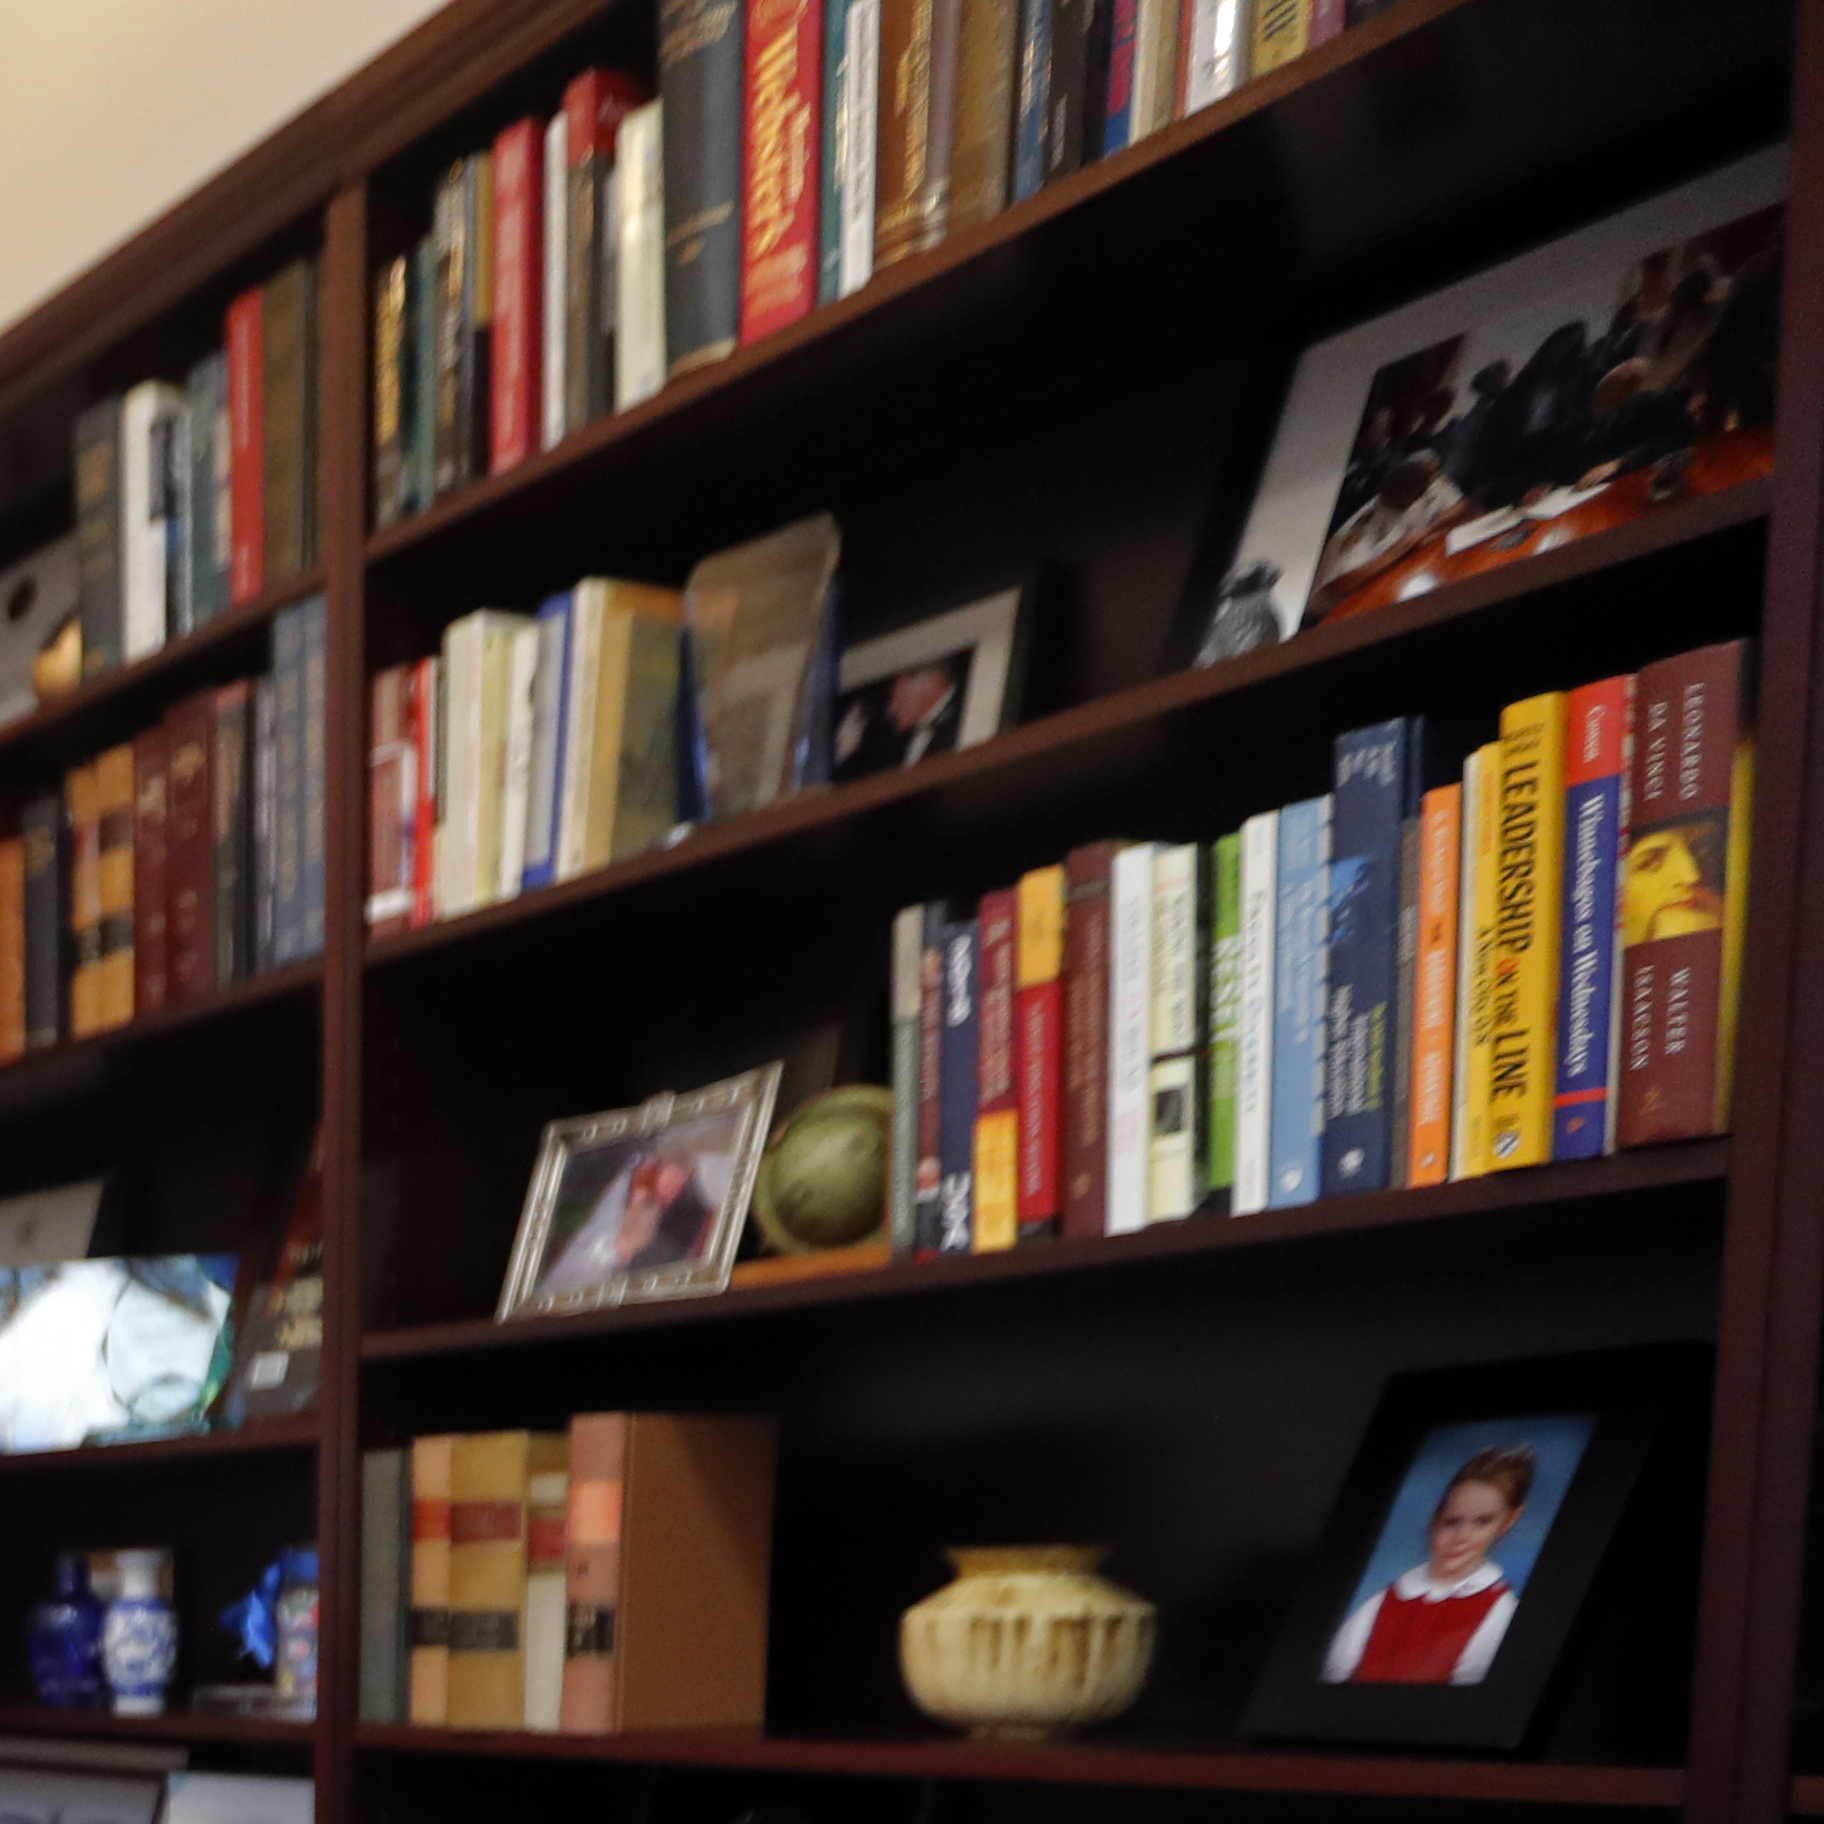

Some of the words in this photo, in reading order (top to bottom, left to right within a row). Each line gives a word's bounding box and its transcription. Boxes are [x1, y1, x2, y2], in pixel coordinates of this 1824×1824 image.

[1648, 701, 1668, 733] DA
[1679, 682, 1705, 801] LEONARDO
[1644, 737, 1667, 801] VINCI
[1497, 760, 1540, 953] LEADERSHIP
[1630, 965, 1654, 1071] ISAACSON
[1663, 967, 1691, 1056] WALTER
[1489, 1027, 1530, 1103] LINE
